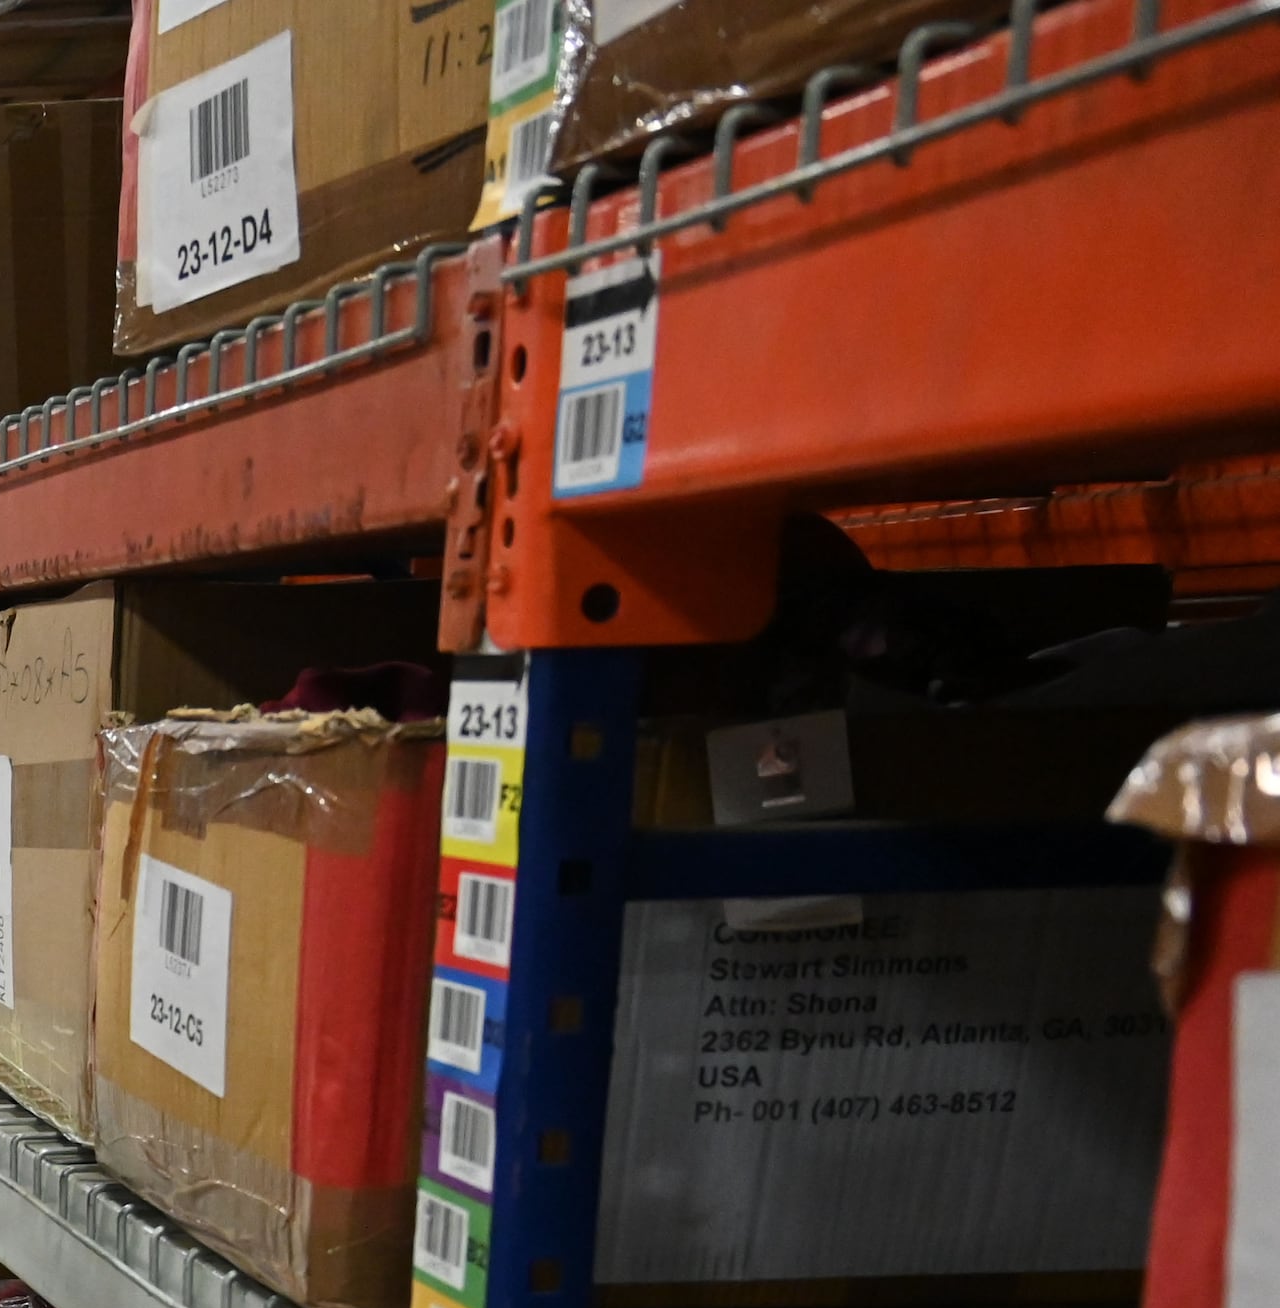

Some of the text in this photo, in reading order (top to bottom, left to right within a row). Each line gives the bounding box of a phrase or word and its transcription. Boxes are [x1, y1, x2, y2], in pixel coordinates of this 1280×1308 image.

[177, 208, 272, 281] 23-12-D4
[580, 322, 636, 367] 23-13
[458, 704, 519, 740] 23-13
[709, 953, 969, 982] Stewart Simmons
[150, 993, 204, 1047] 23-12-C5
[703, 995, 776, 1018] Attn:
[700, 1029, 770, 1054] 2362
[863, 1024, 912, 1051] Rd,
[920, 1019, 1030, 1045] Atlanta,
[697, 1065, 763, 1088] USA
[752, 1099, 801, 1121] 001
[811, 1095, 881, 1125] (407)
[889, 1090, 1017, 1116] 463-8512
